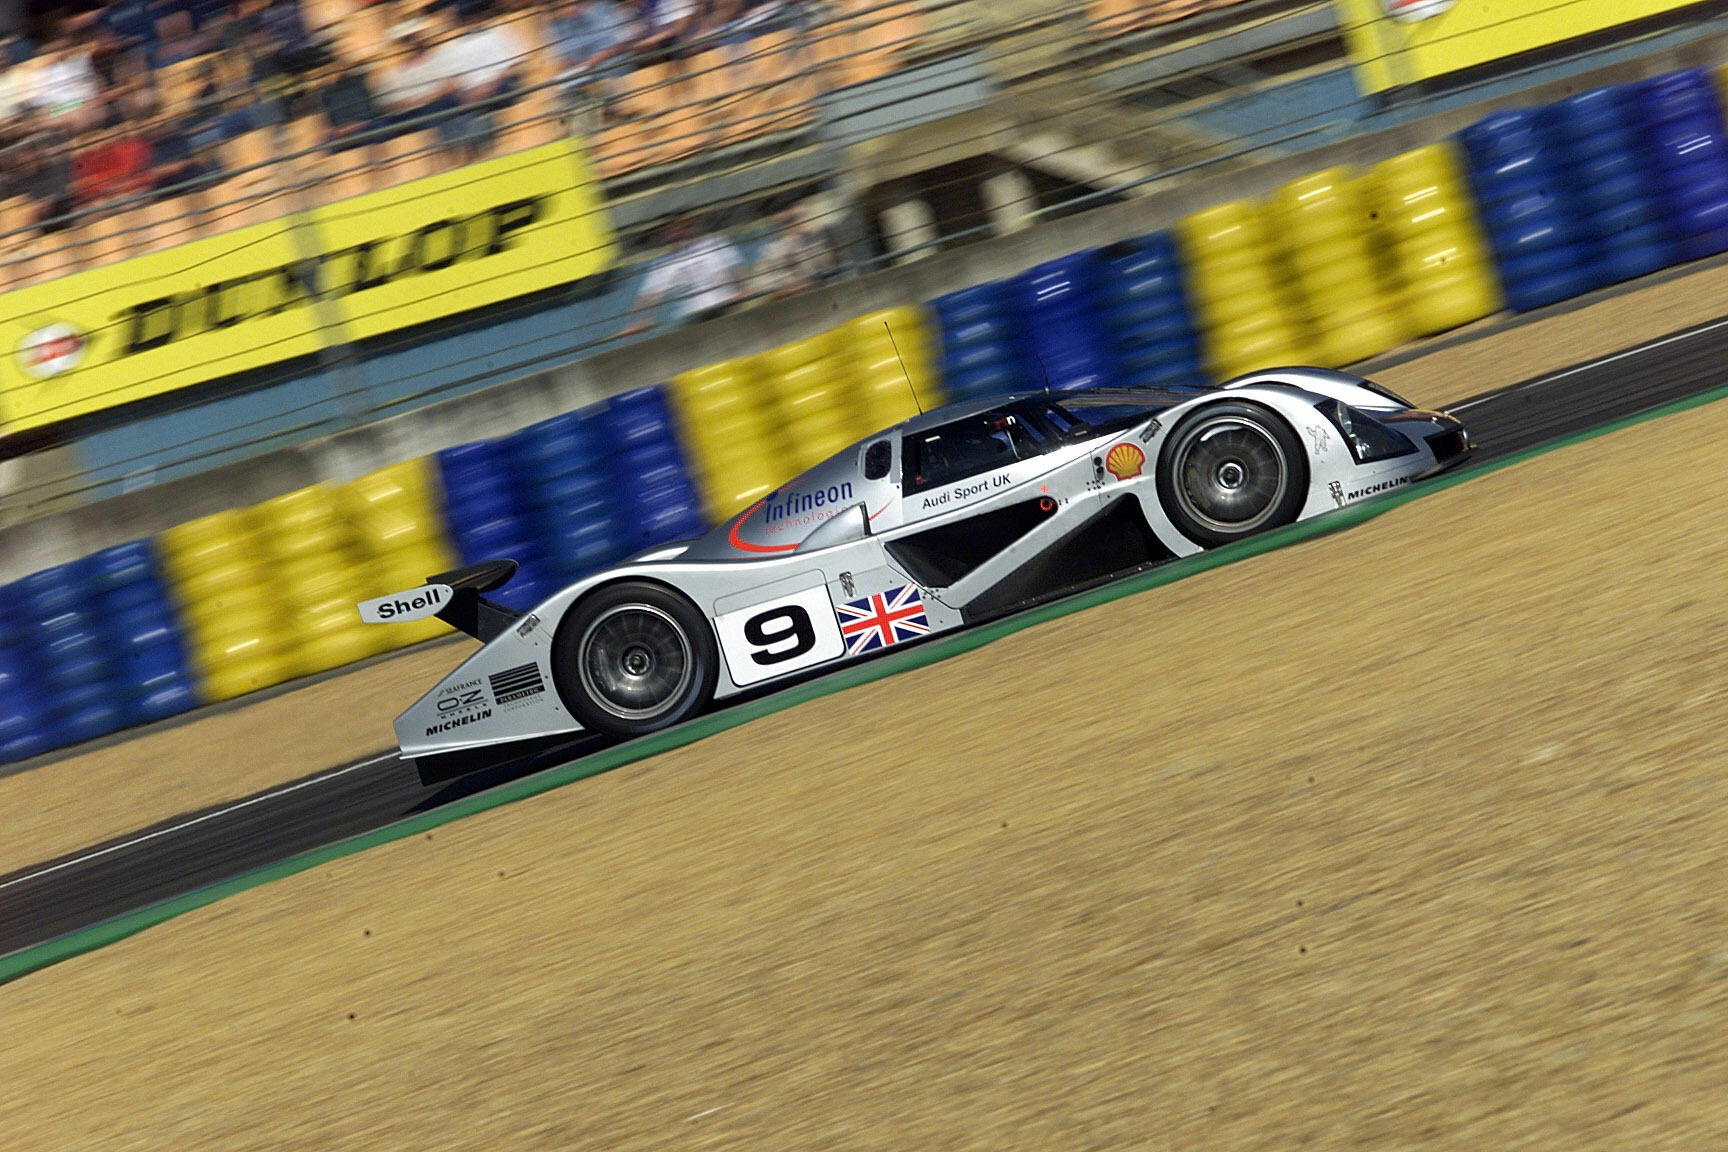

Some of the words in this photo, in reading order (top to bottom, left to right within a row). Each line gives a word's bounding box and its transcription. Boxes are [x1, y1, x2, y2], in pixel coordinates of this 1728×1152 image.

[765, 481, 853, 524] Infineon
[922, 490, 951, 509] Audi
[954, 480, 989, 500] Sport
[993, 473, 1012, 488] UK
[1347, 476, 1408, 500] MICHELIN
[378, 588, 441, 619] Shell
[743, 604, 816, 666] 9
[426, 708, 492, 736] MICHELIN
